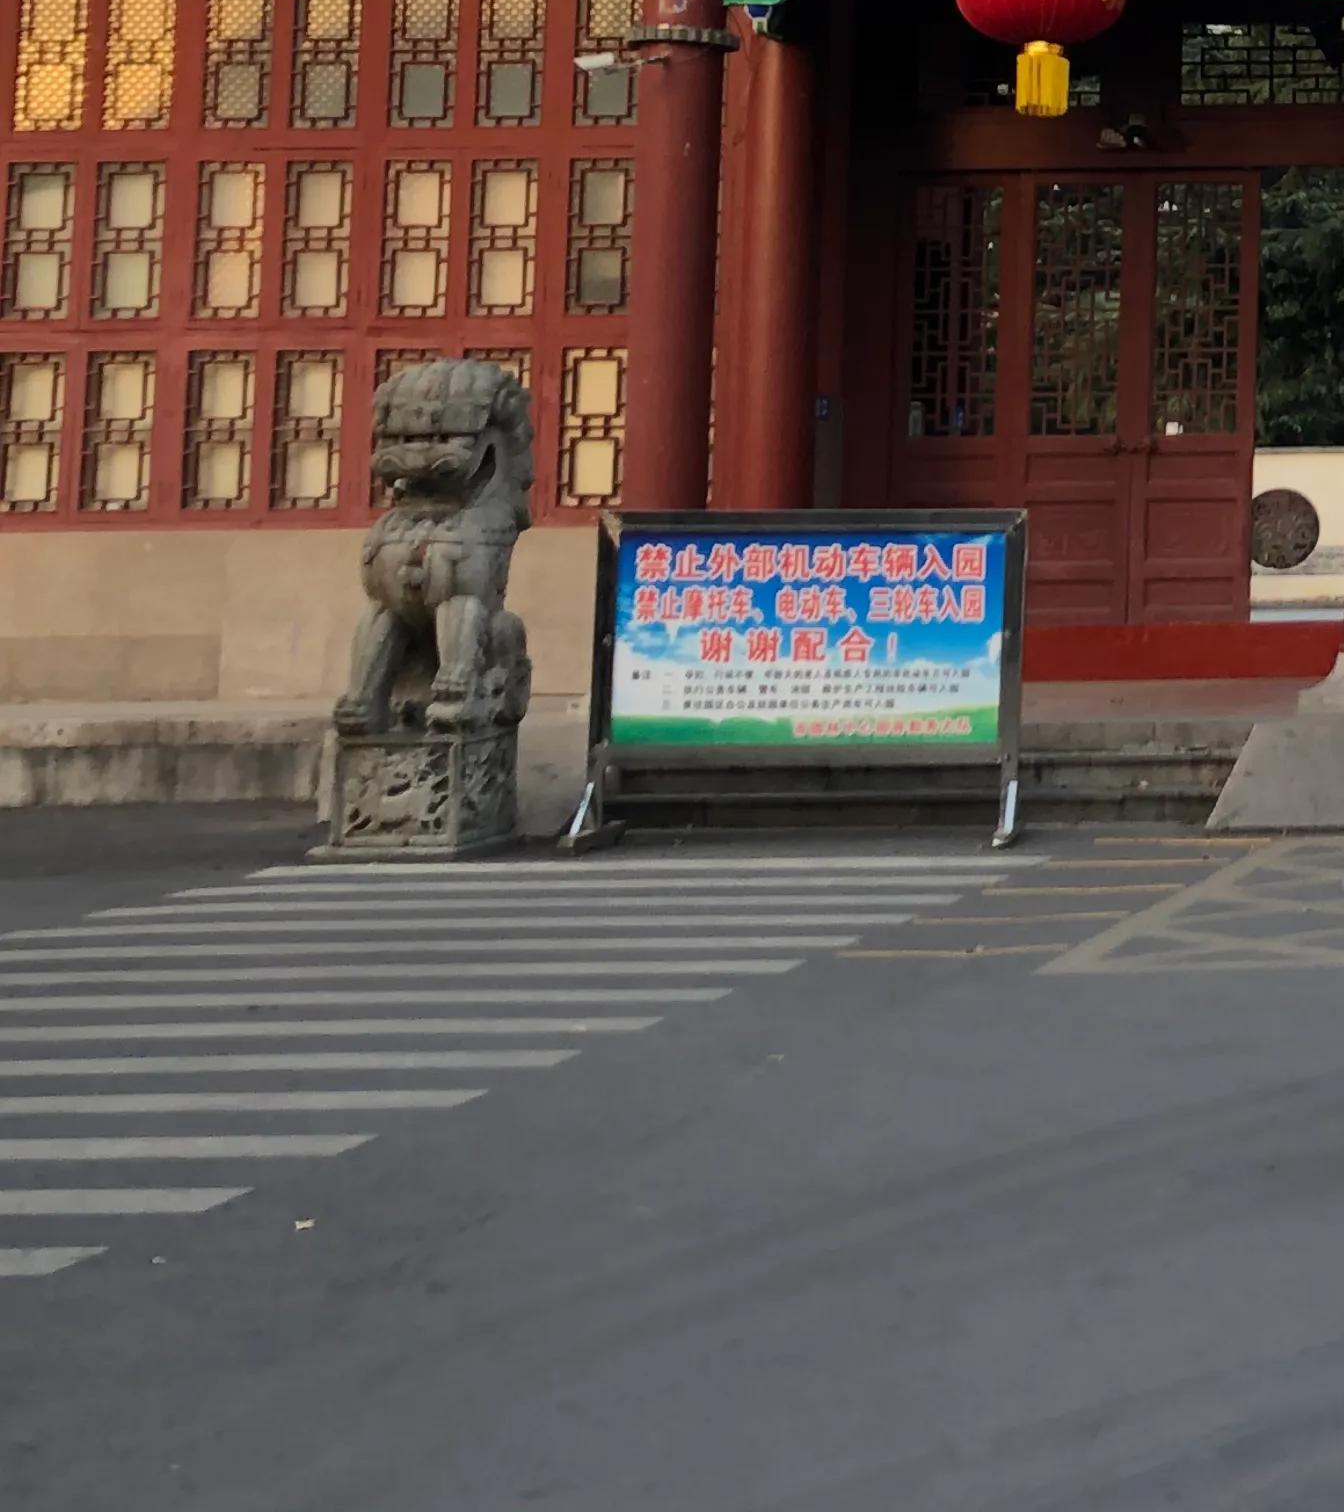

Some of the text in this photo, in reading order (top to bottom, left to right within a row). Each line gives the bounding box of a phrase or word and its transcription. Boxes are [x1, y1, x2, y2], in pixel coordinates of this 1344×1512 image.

[637, 544, 986, 581] 禁止外部机动车辆入园
